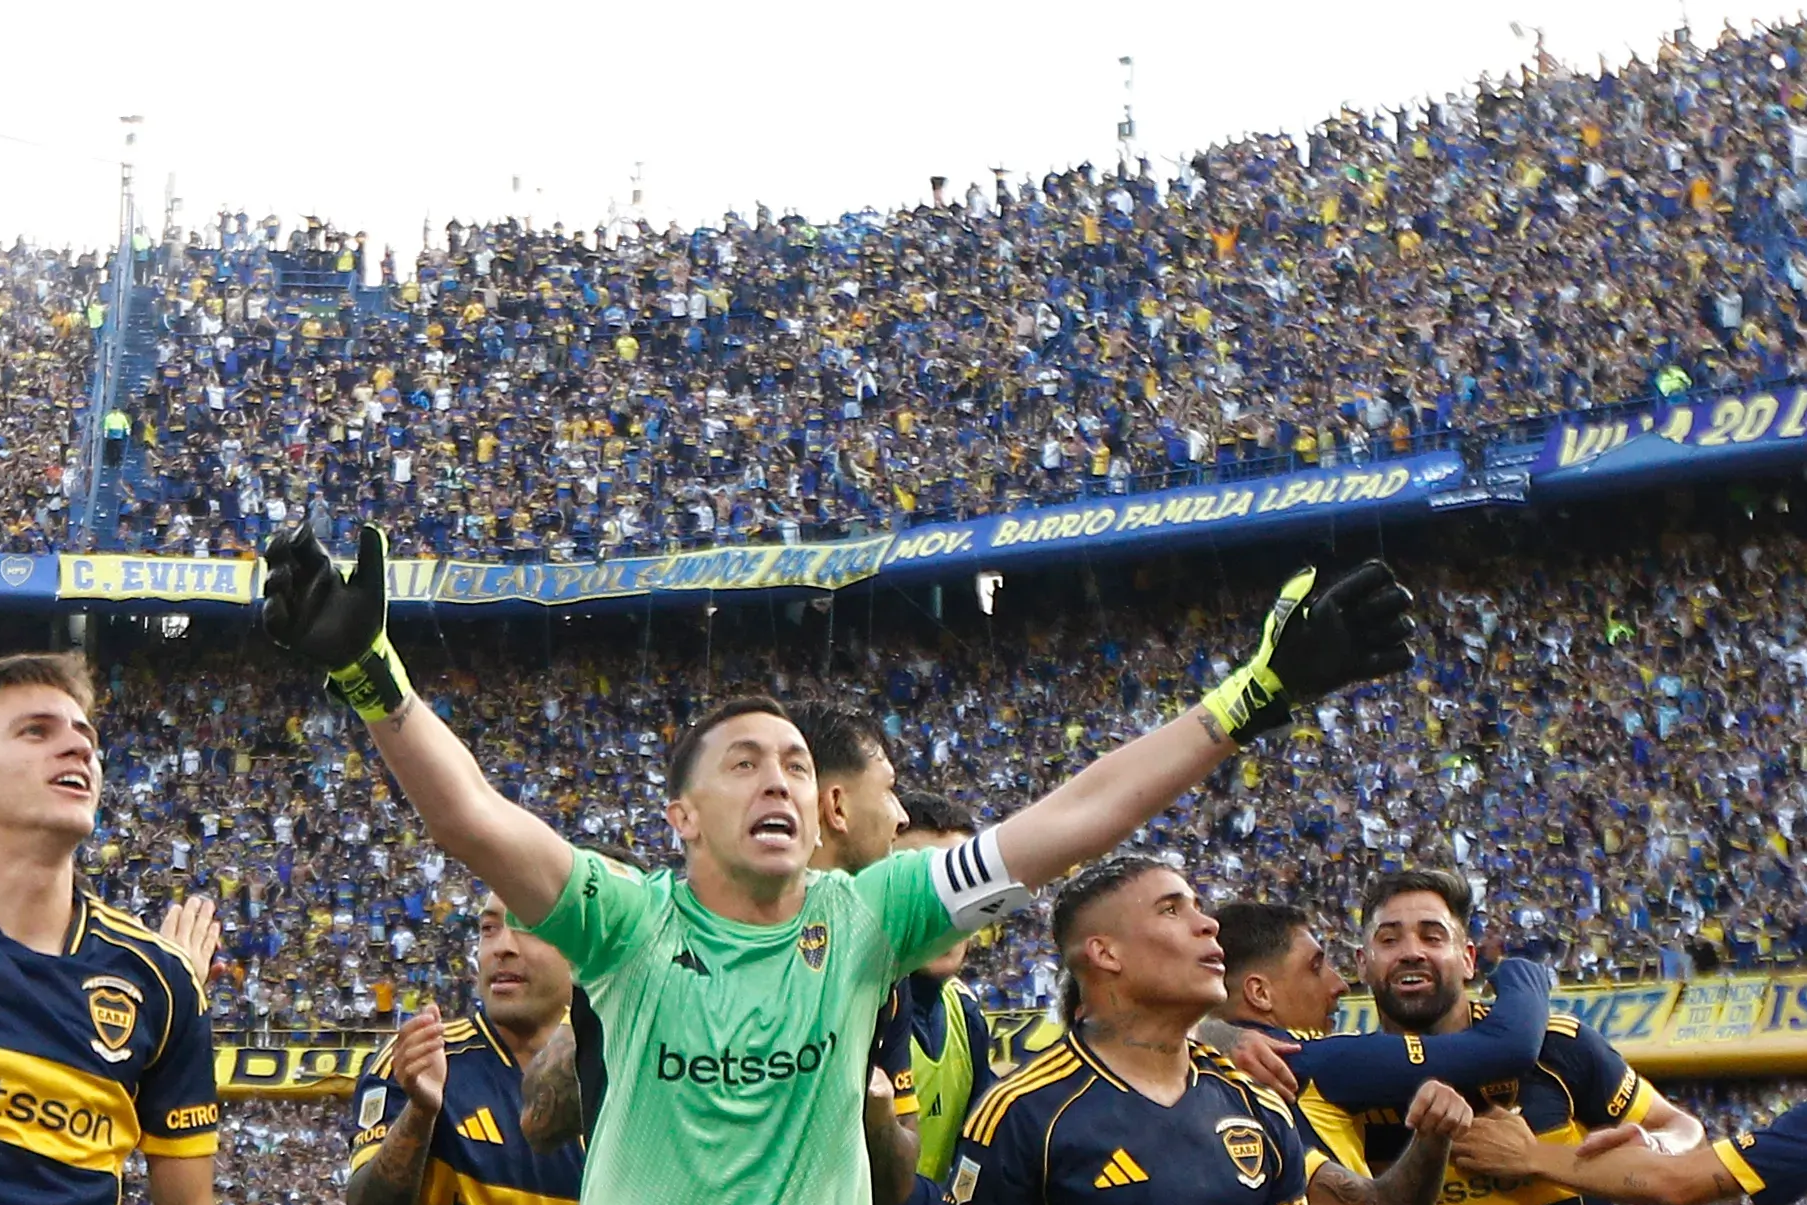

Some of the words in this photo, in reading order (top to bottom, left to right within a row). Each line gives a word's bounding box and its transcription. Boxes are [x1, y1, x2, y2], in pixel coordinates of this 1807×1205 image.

[1697, 394, 1780, 446] 20
[884, 530, 975, 564] MOV.
[990, 508, 1116, 548] BARRIO
[1115, 491, 1255, 532] FAMILIA
[1258, 468, 1410, 513] LEALTAD
[121, 561, 237, 594] EVITA
